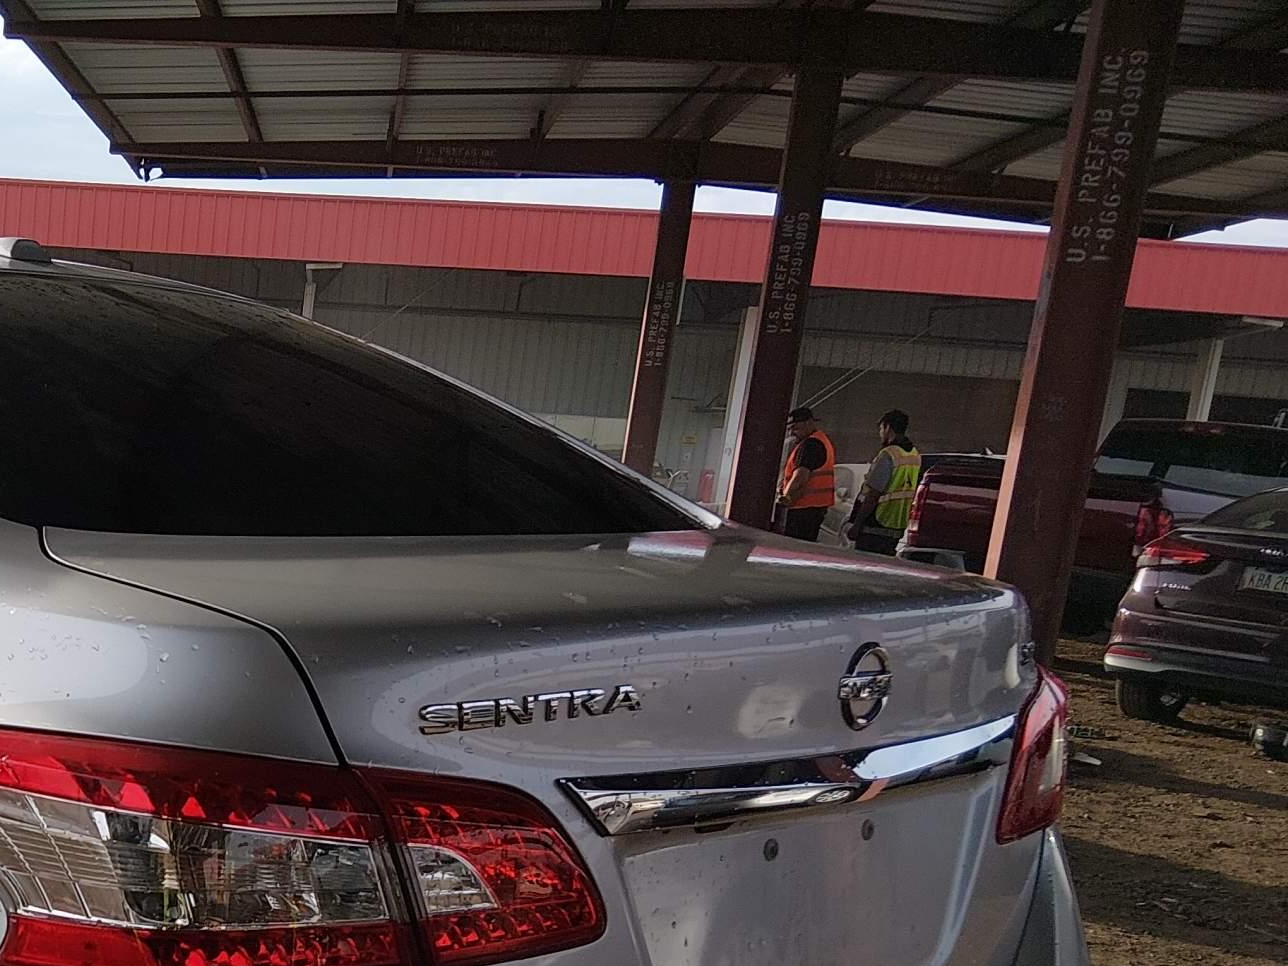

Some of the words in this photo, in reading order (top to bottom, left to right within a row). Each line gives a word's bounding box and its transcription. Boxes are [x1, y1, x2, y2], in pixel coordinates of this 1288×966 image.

[1078, 107, 1113, 203] PREFAB
[1091, 50, 1150, 262] 1-866-799-0969
[1065, 216, 1094, 263] U.S.
[772, 243, 791, 299] PREFAB
[648, 303, 662, 343] PREFAB
[418, 684, 642, 735] SENTRA
